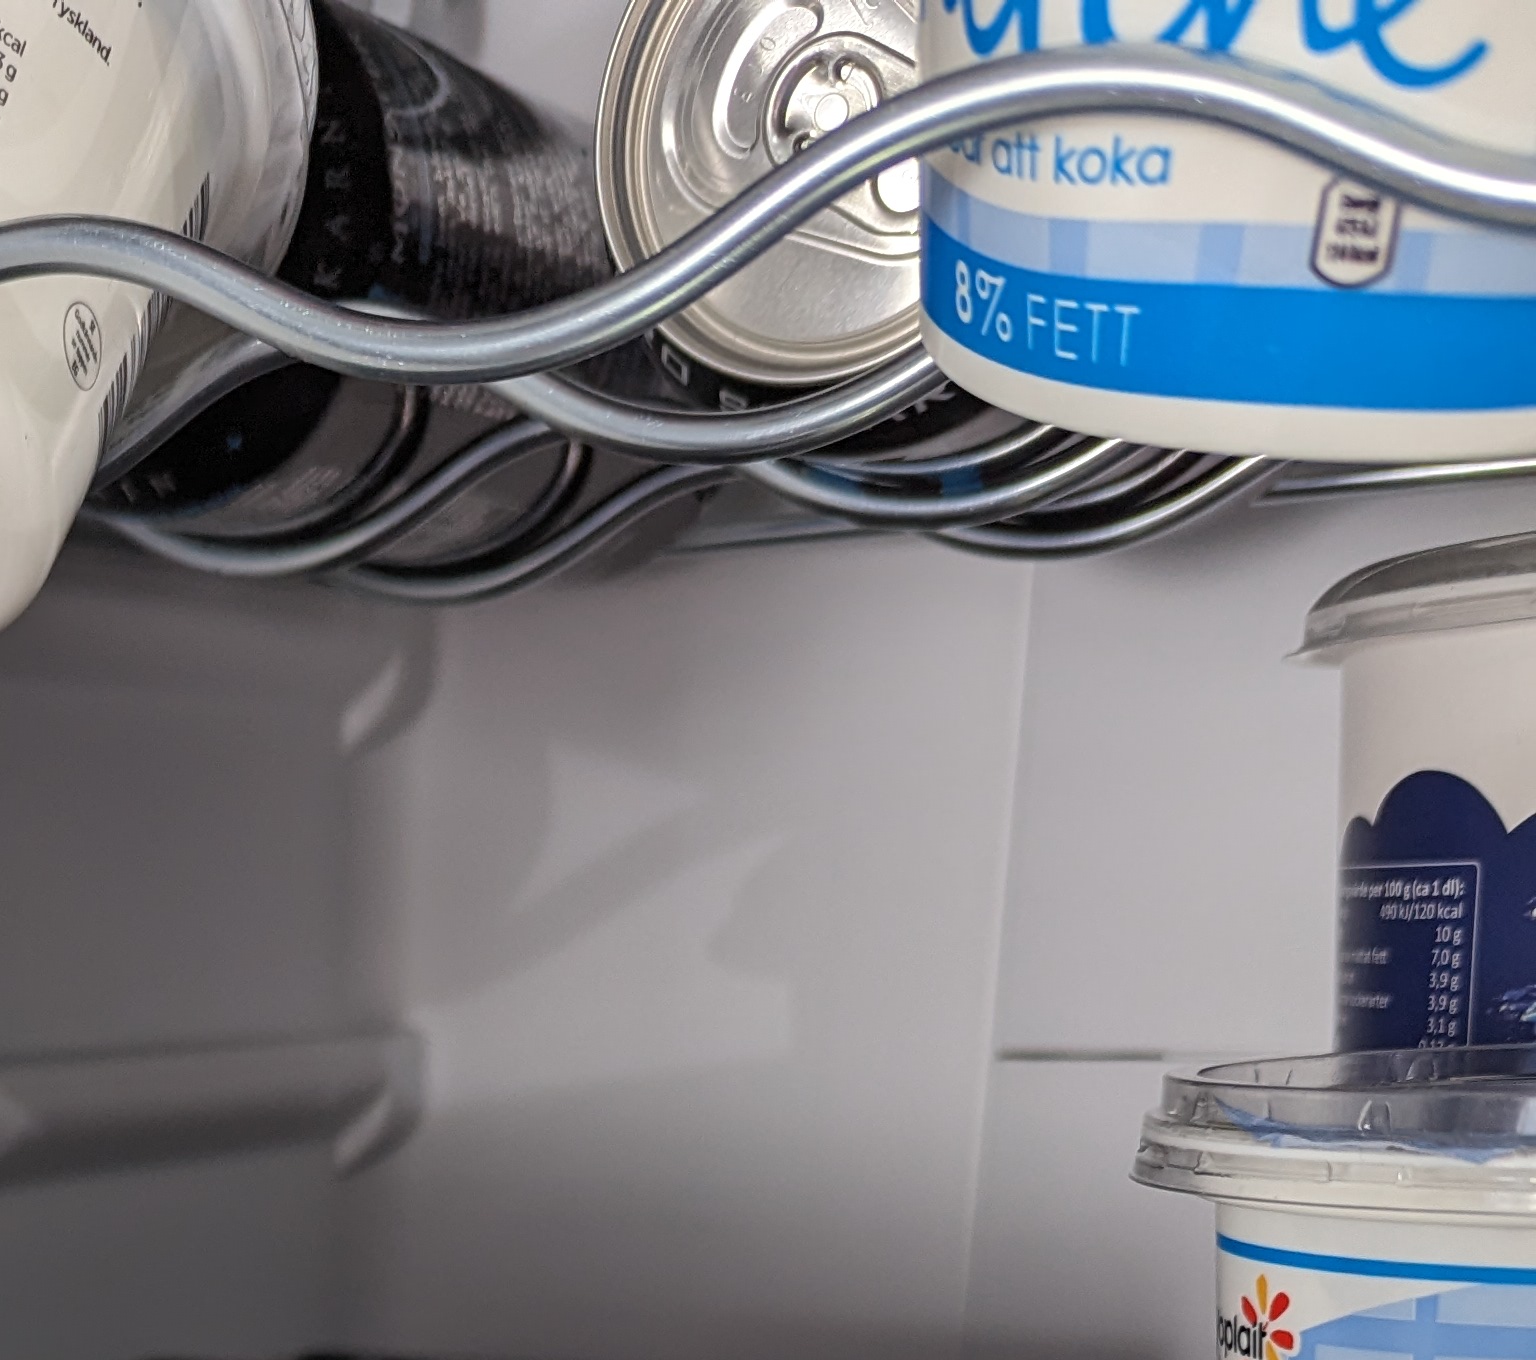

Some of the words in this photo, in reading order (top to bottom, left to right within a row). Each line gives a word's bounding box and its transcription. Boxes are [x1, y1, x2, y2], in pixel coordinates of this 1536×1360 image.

[991, 135, 1039, 183] att
[1051, 136, 1173, 189] koka
[954, 258, 1014, 344] 8%
[1026, 293, 1141, 367] FETT
[1384, 880, 1402, 898] 100
[1437, 901, 1463, 919] kcal
[1435, 926, 1450, 943] 10
[1432, 949, 1449, 967] 7,0
[1429, 972, 1447, 990] 3,9
[1428, 995, 1446, 1013] 3,9
[1427, 1018, 1444, 1036] 3,1
